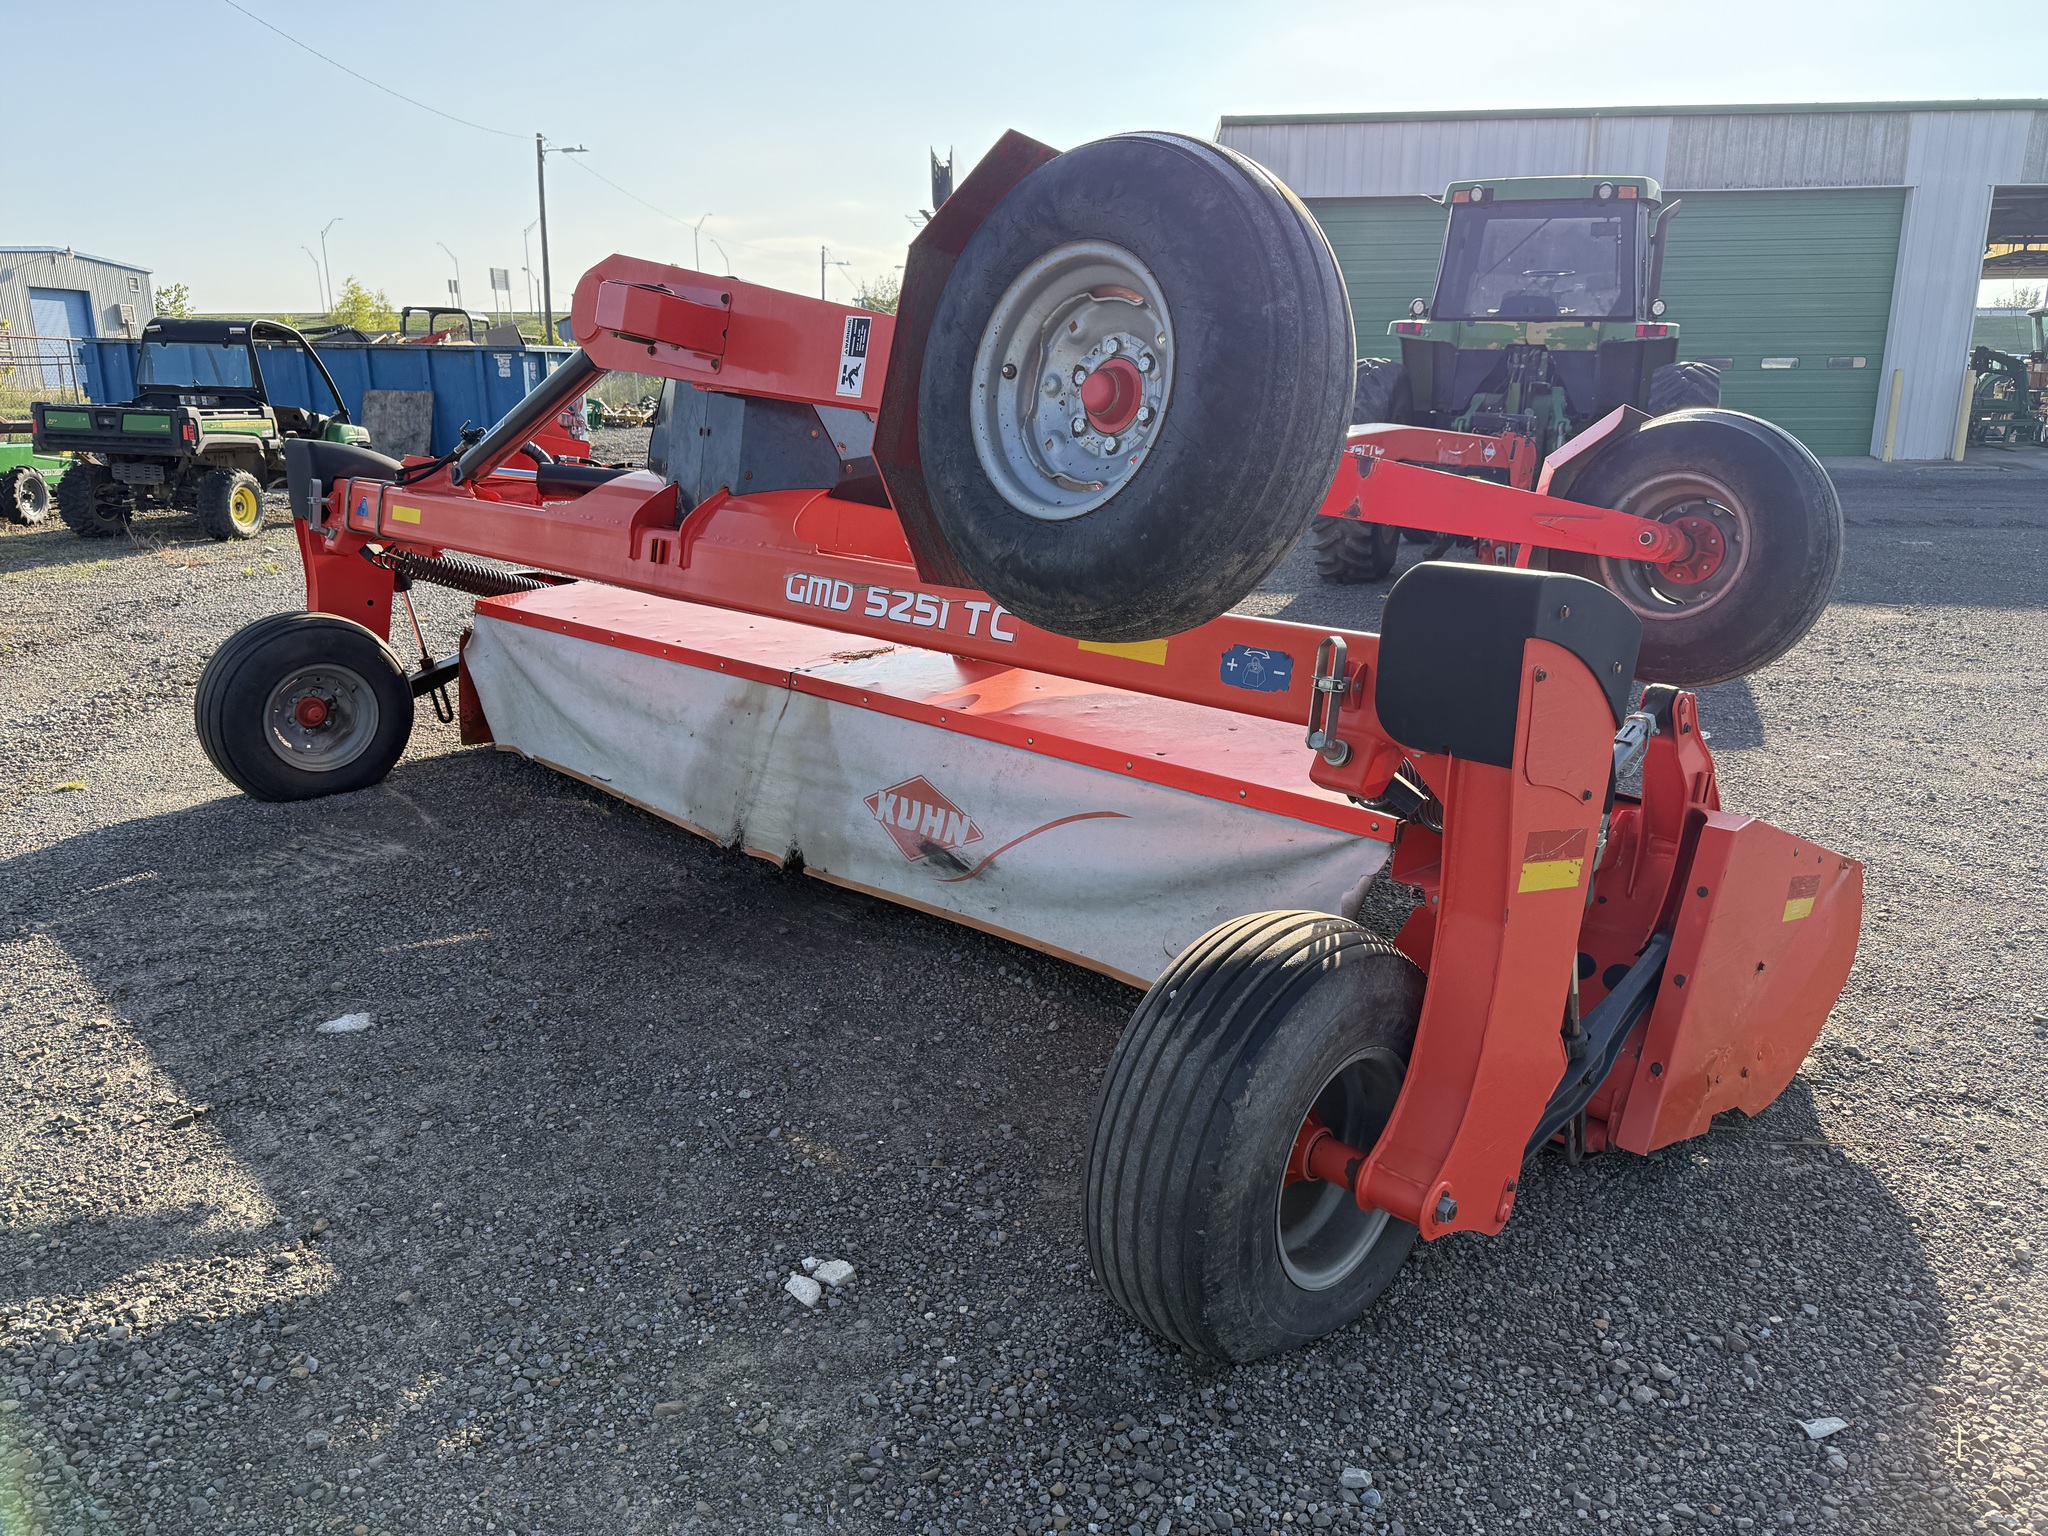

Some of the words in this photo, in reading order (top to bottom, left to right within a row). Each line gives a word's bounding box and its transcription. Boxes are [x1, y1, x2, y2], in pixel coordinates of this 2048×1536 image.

[844, 319, 852, 349] WARNING
[784, 573, 855, 612] GMD
[864, 586, 950, 630] 5251
[964, 601, 1015, 642] TC
[874, 789, 971, 848] KUHN
